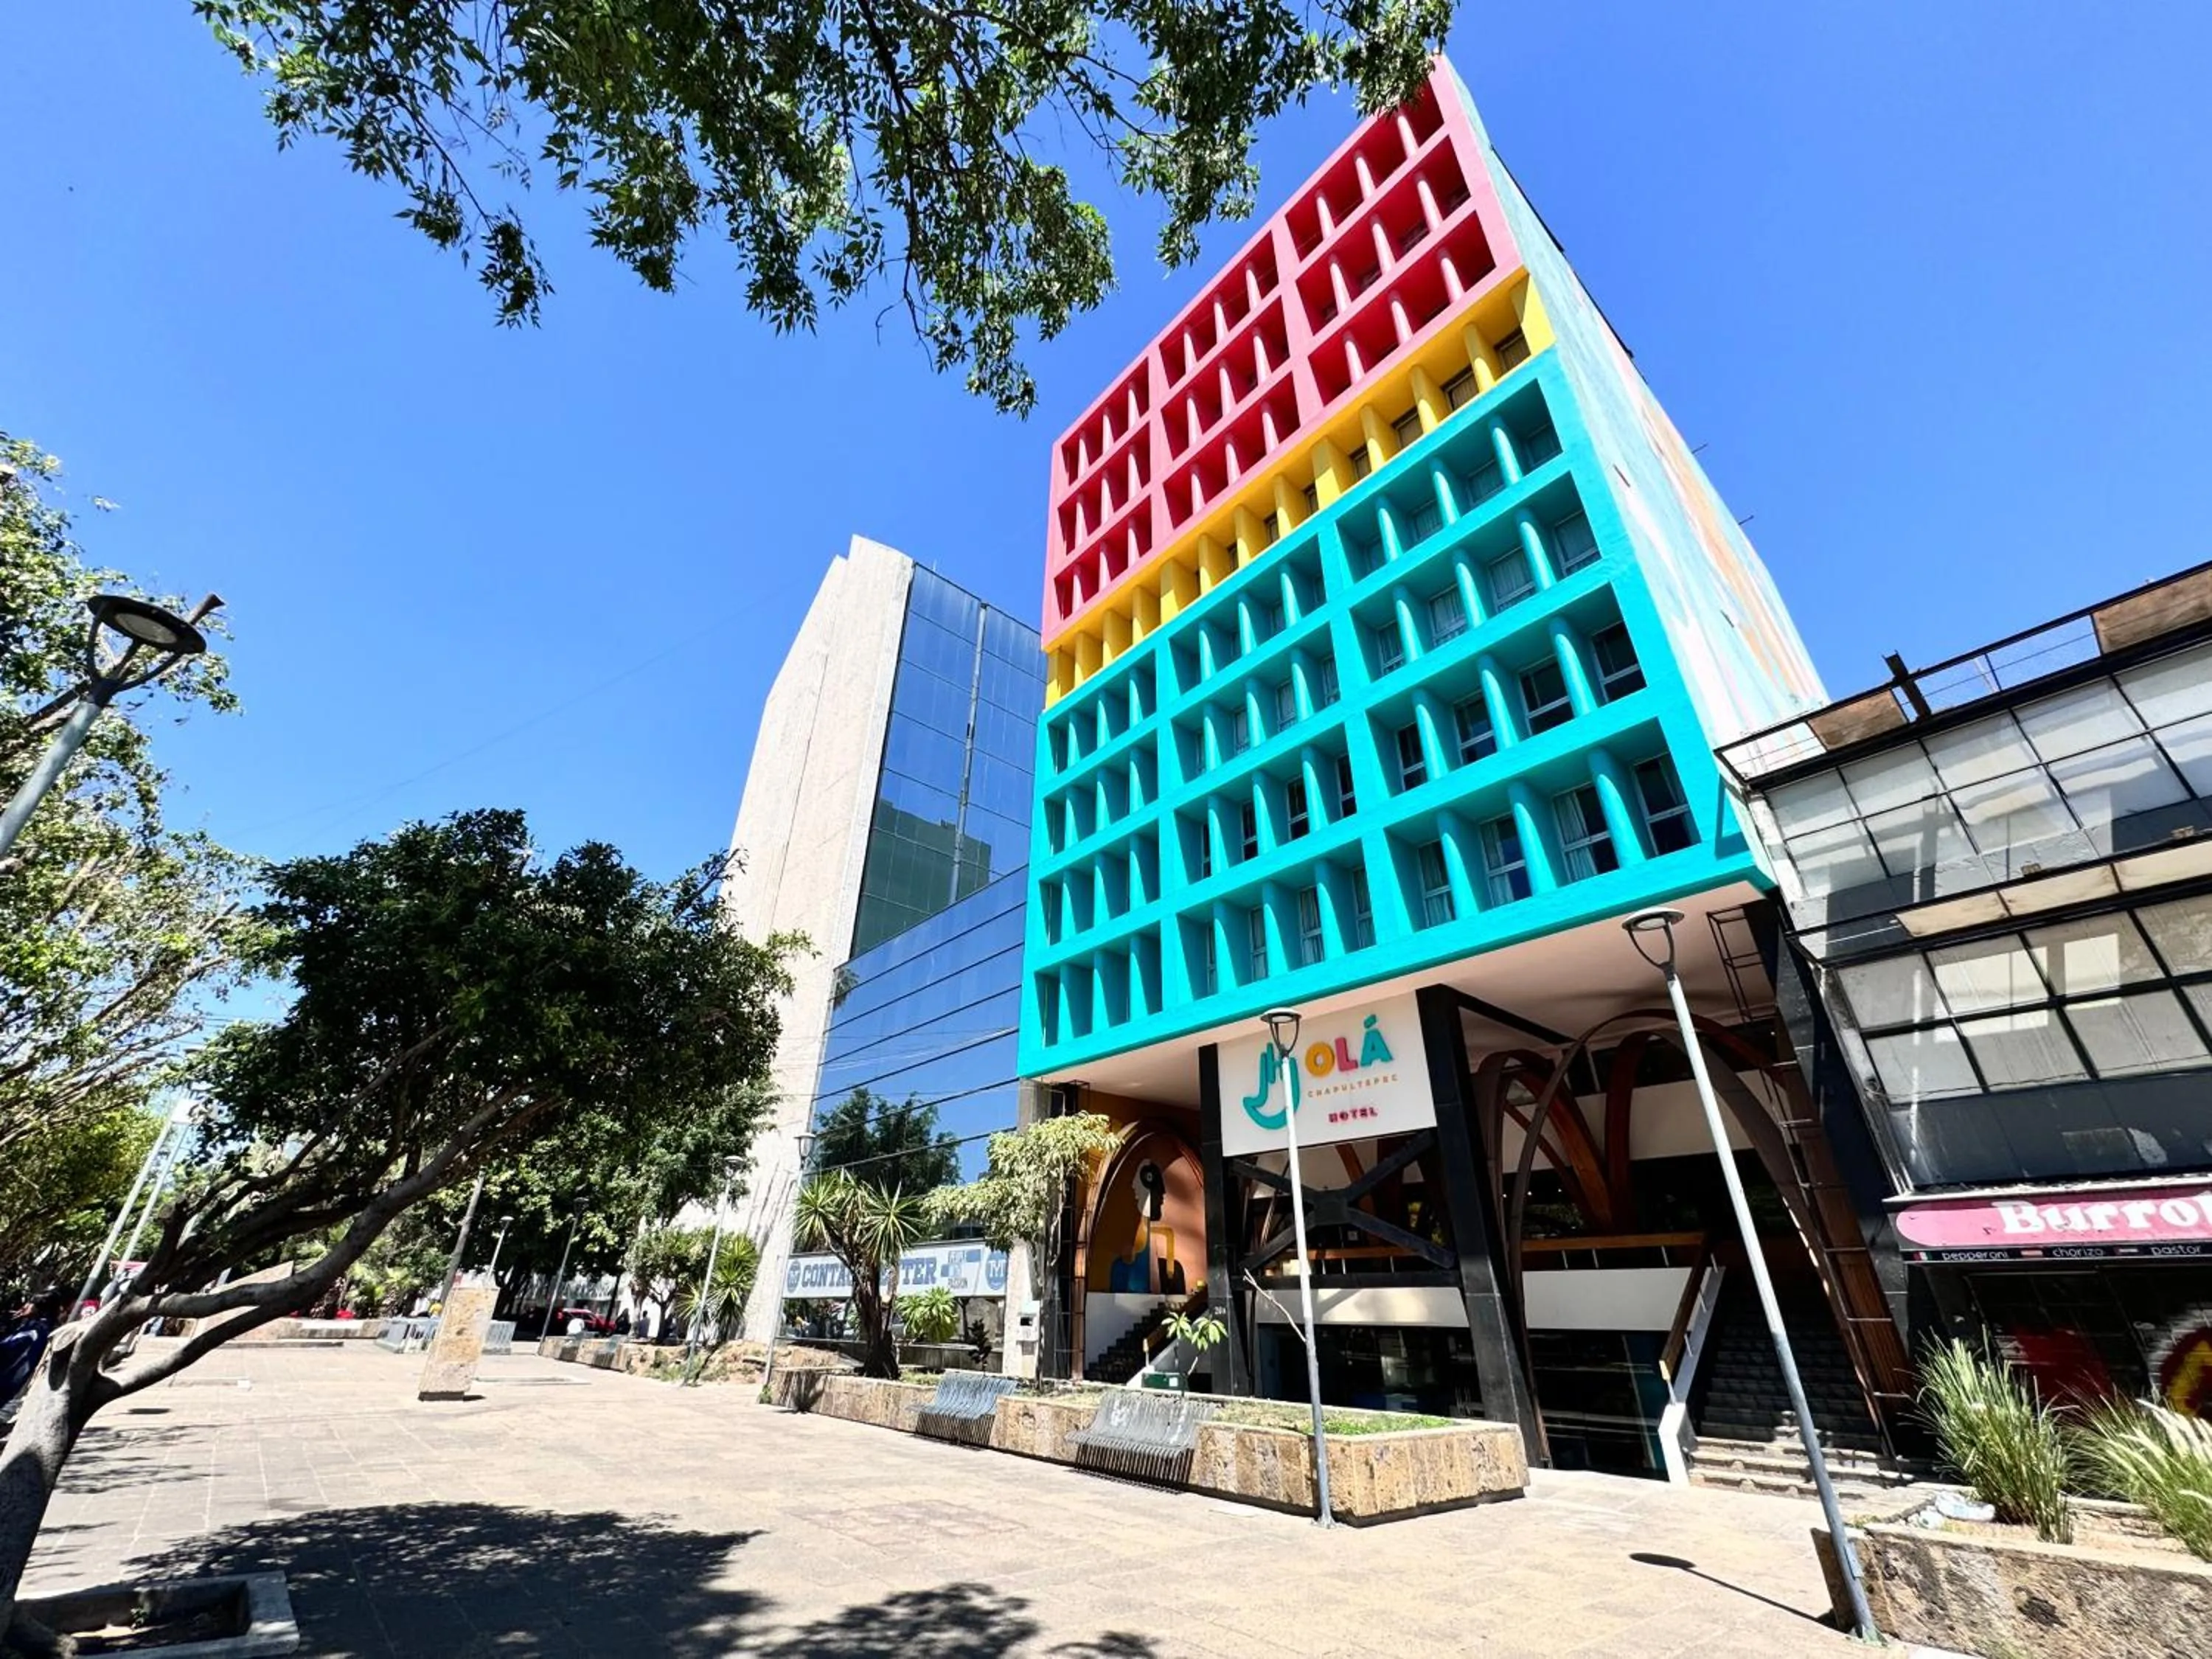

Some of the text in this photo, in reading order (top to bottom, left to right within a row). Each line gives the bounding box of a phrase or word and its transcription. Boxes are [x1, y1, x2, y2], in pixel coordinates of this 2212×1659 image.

[1307, 1074, 1398, 1097] CHAPULTEPEC
[1328, 1107, 1378, 1122] HOTEL
[1941, 1250, 2009, 1261] pepperoni
[2052, 1246, 2104, 1257] chorizo
[2150, 1244, 2201, 1256] pastor
